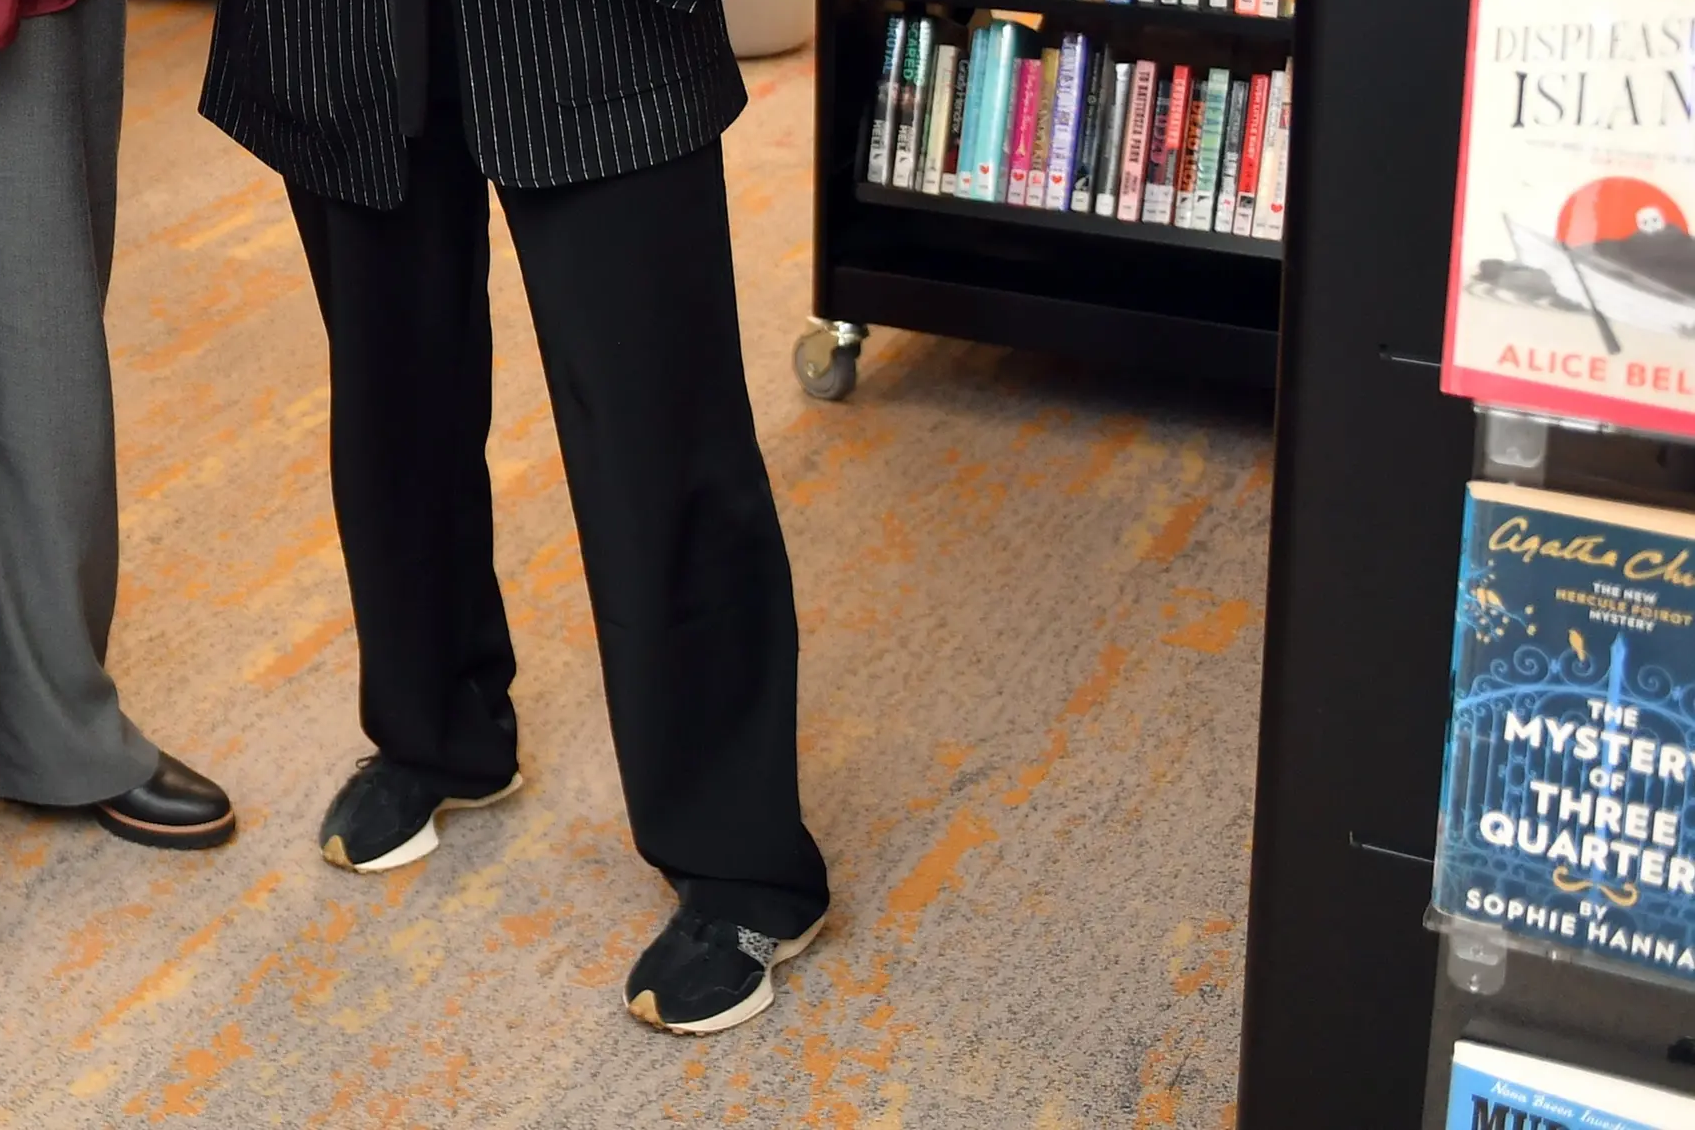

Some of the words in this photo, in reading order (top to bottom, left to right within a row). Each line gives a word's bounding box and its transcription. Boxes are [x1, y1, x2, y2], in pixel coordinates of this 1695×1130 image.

[902, 22, 920, 80] SCARED
[1129, 137, 1144, 164] PARK
[1497, 343, 1608, 382] ALICE
[1488, 514, 1617, 569] Agatha
[1555, 587, 1626, 613] HERCULE
[1630, 601, 1694, 627] POIROT
[1593, 581, 1620, 599] THE
[1623, 586, 1658, 605] NEW
[1588, 608, 1654, 632] MYSTERY
[1588, 698, 1640, 728] THE
[1589, 766, 1625, 792] OF
[1530, 781, 1679, 848] THREE
[1579, 900, 1608, 920] BY
[1466, 888, 1578, 938] SOPHIE
[1588, 923, 1695, 972] HANNA
